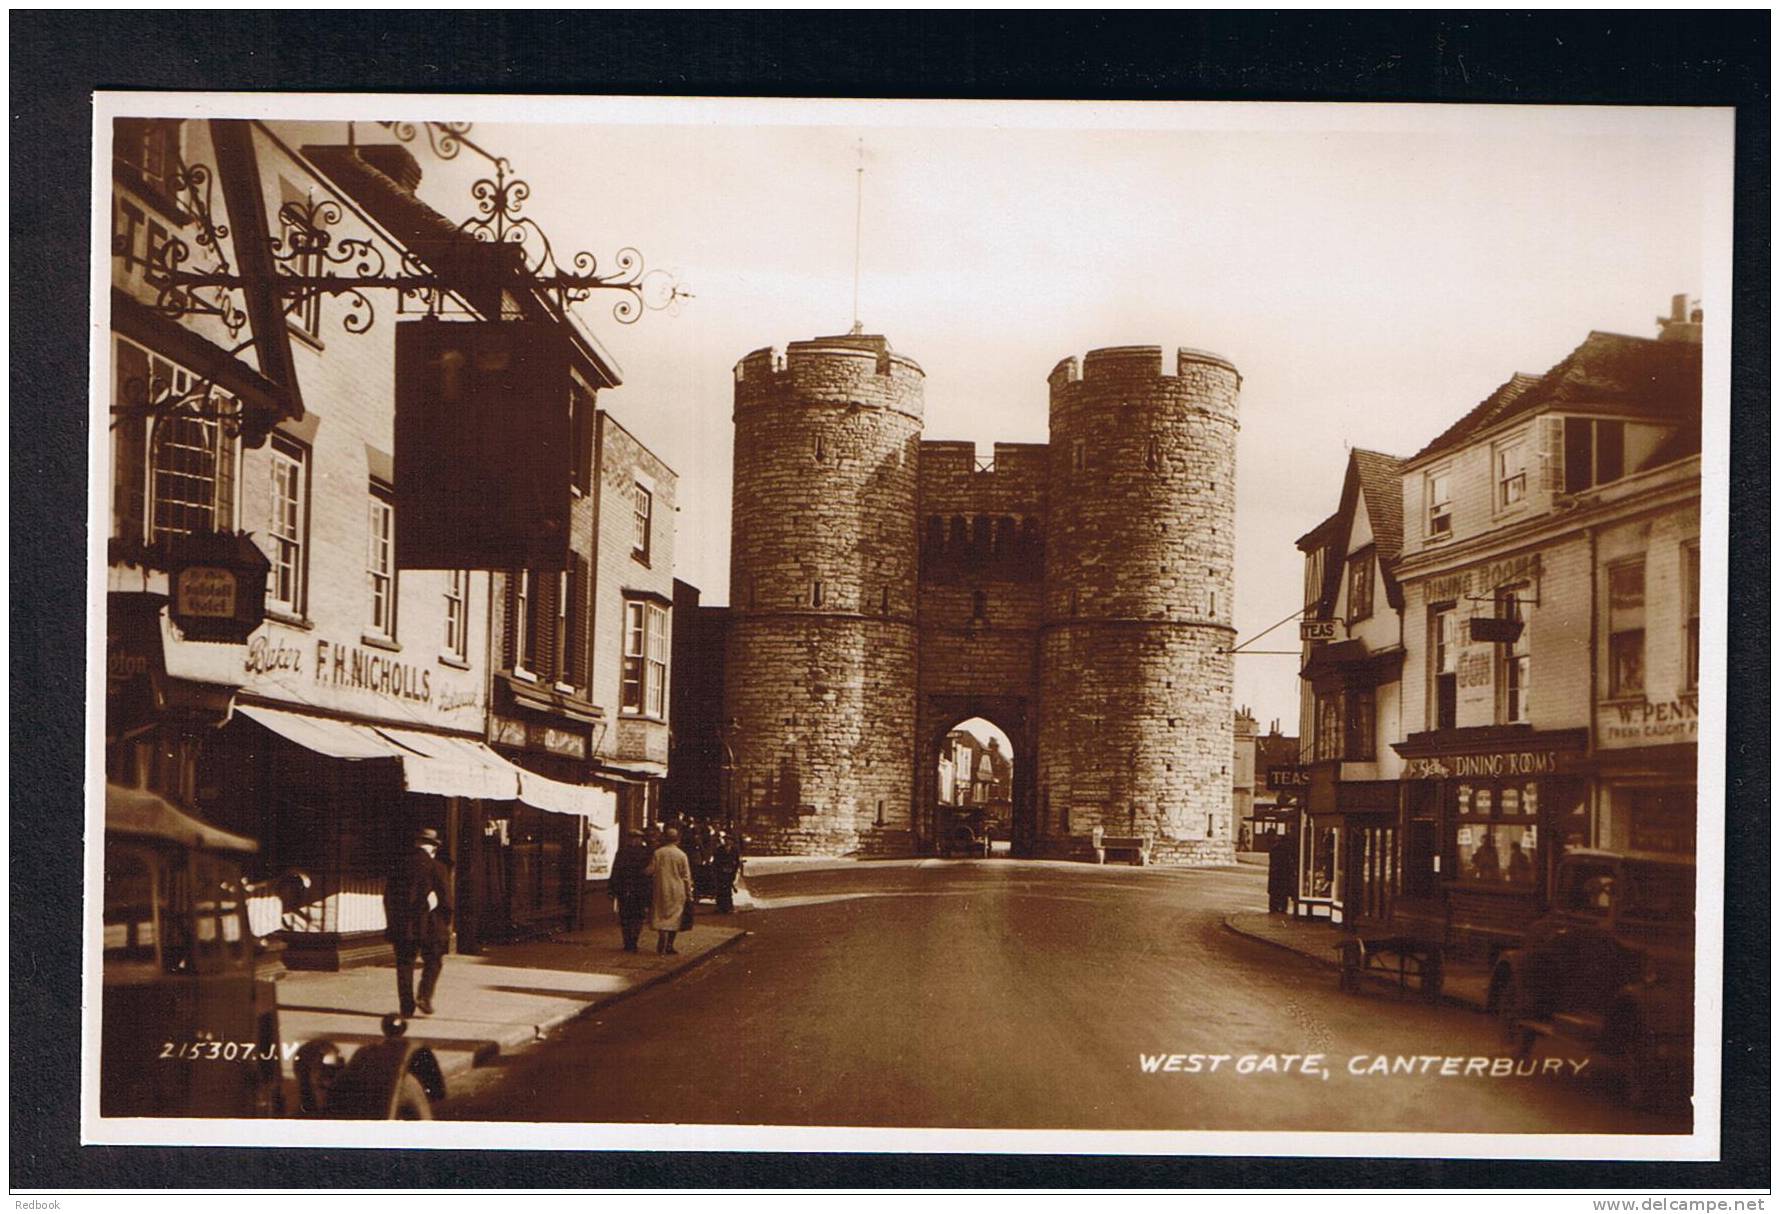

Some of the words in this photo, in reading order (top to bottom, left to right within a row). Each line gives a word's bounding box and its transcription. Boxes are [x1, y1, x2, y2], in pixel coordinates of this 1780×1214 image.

[1424, 571, 1473, 601] DINING
[1303, 624, 1335, 637] TEAS
[1644, 722, 1685, 737] CAUGHT
[1456, 755, 1503, 778] DINING
[1509, 751, 1556, 776] ROOMS
[1271, 771, 1311, 785] TEAS
